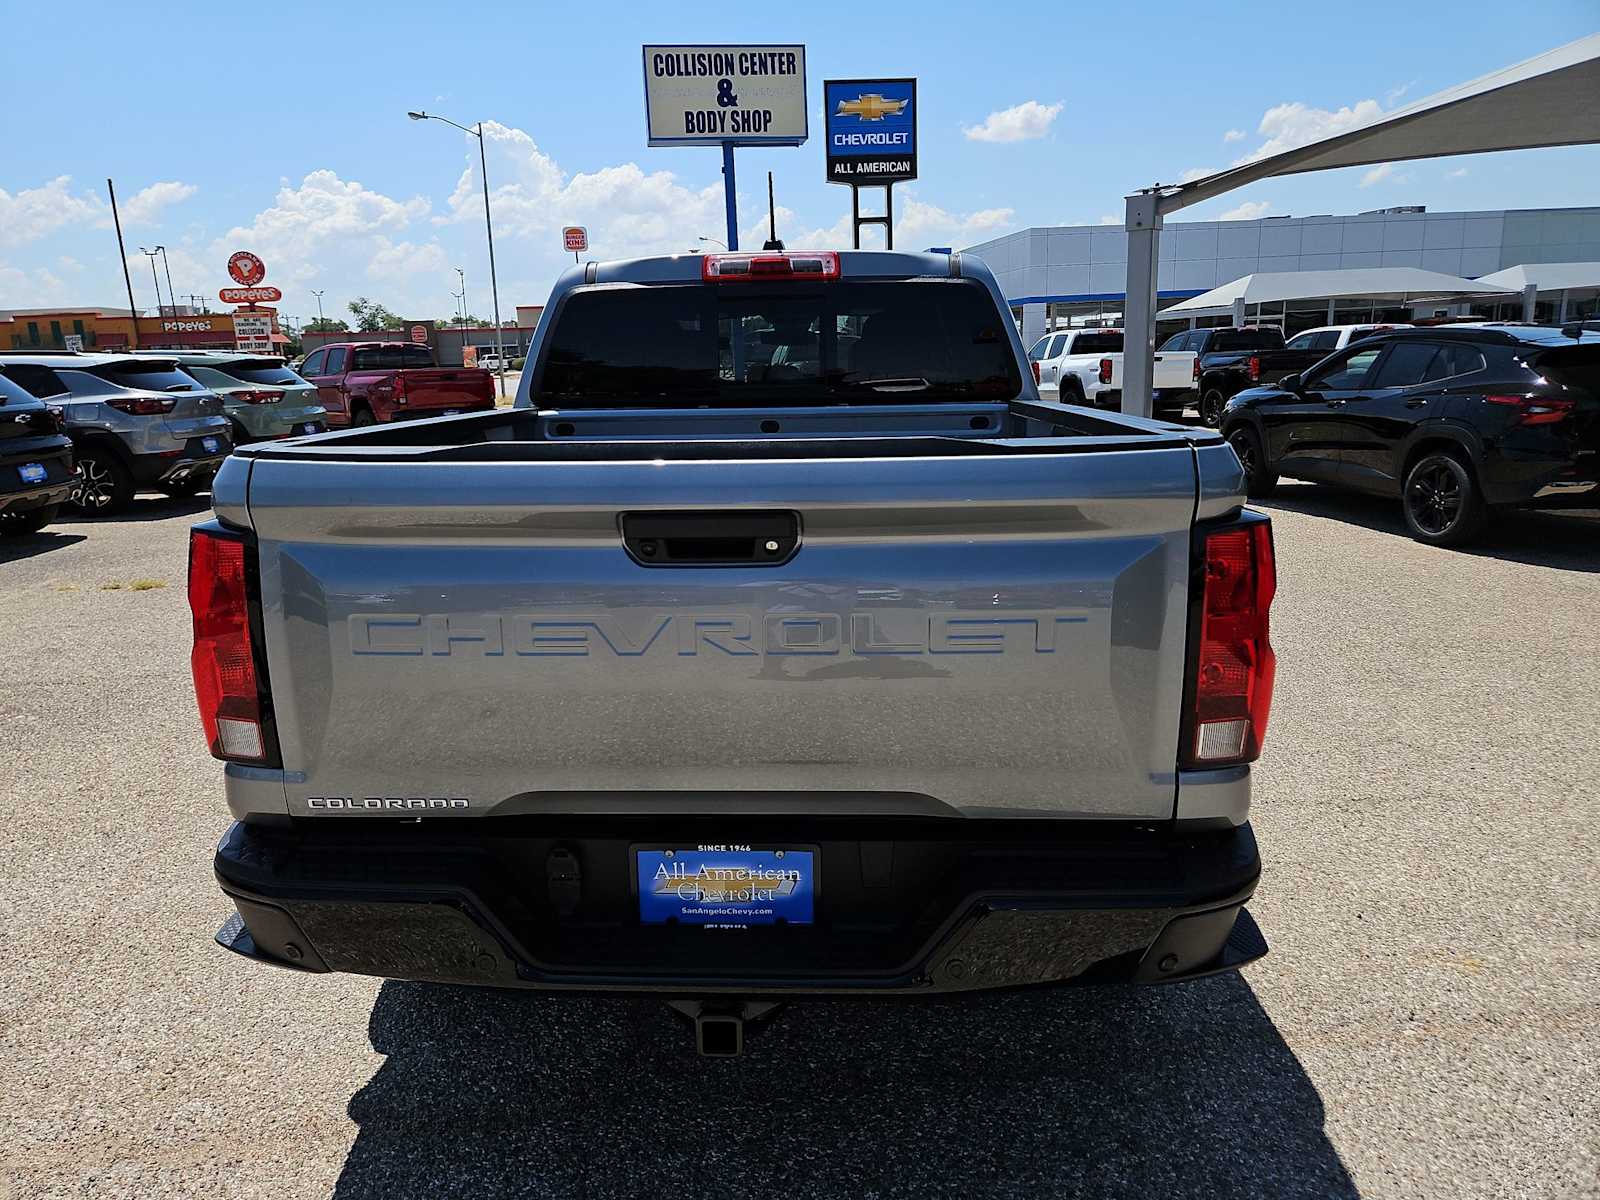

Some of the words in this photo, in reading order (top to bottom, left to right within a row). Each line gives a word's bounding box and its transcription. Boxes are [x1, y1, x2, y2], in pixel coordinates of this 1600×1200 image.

[653, 53, 735, 77] COLLISION
[738, 52, 797, 76] CENTER
[716, 78, 738, 107] &
[684, 110, 727, 133] BODY
[731, 109, 772, 133] SHOP
[834, 132, 908, 146] CHEVROLET
[834, 165, 853, 174] ALL
[856, 161, 910, 173] AMERICAN
[348, 611, 1088, 656] CHEVROLET
[306, 797, 470, 810] COLORADO
[698, 844, 727, 852] SINCE
[729, 844, 751, 852] 1946
[653, 862, 686, 880] All
[695, 863, 802, 881] American
[677, 882, 775, 902] Chevrolet
[681, 906, 773, 916] SanAngeloChevy.com
